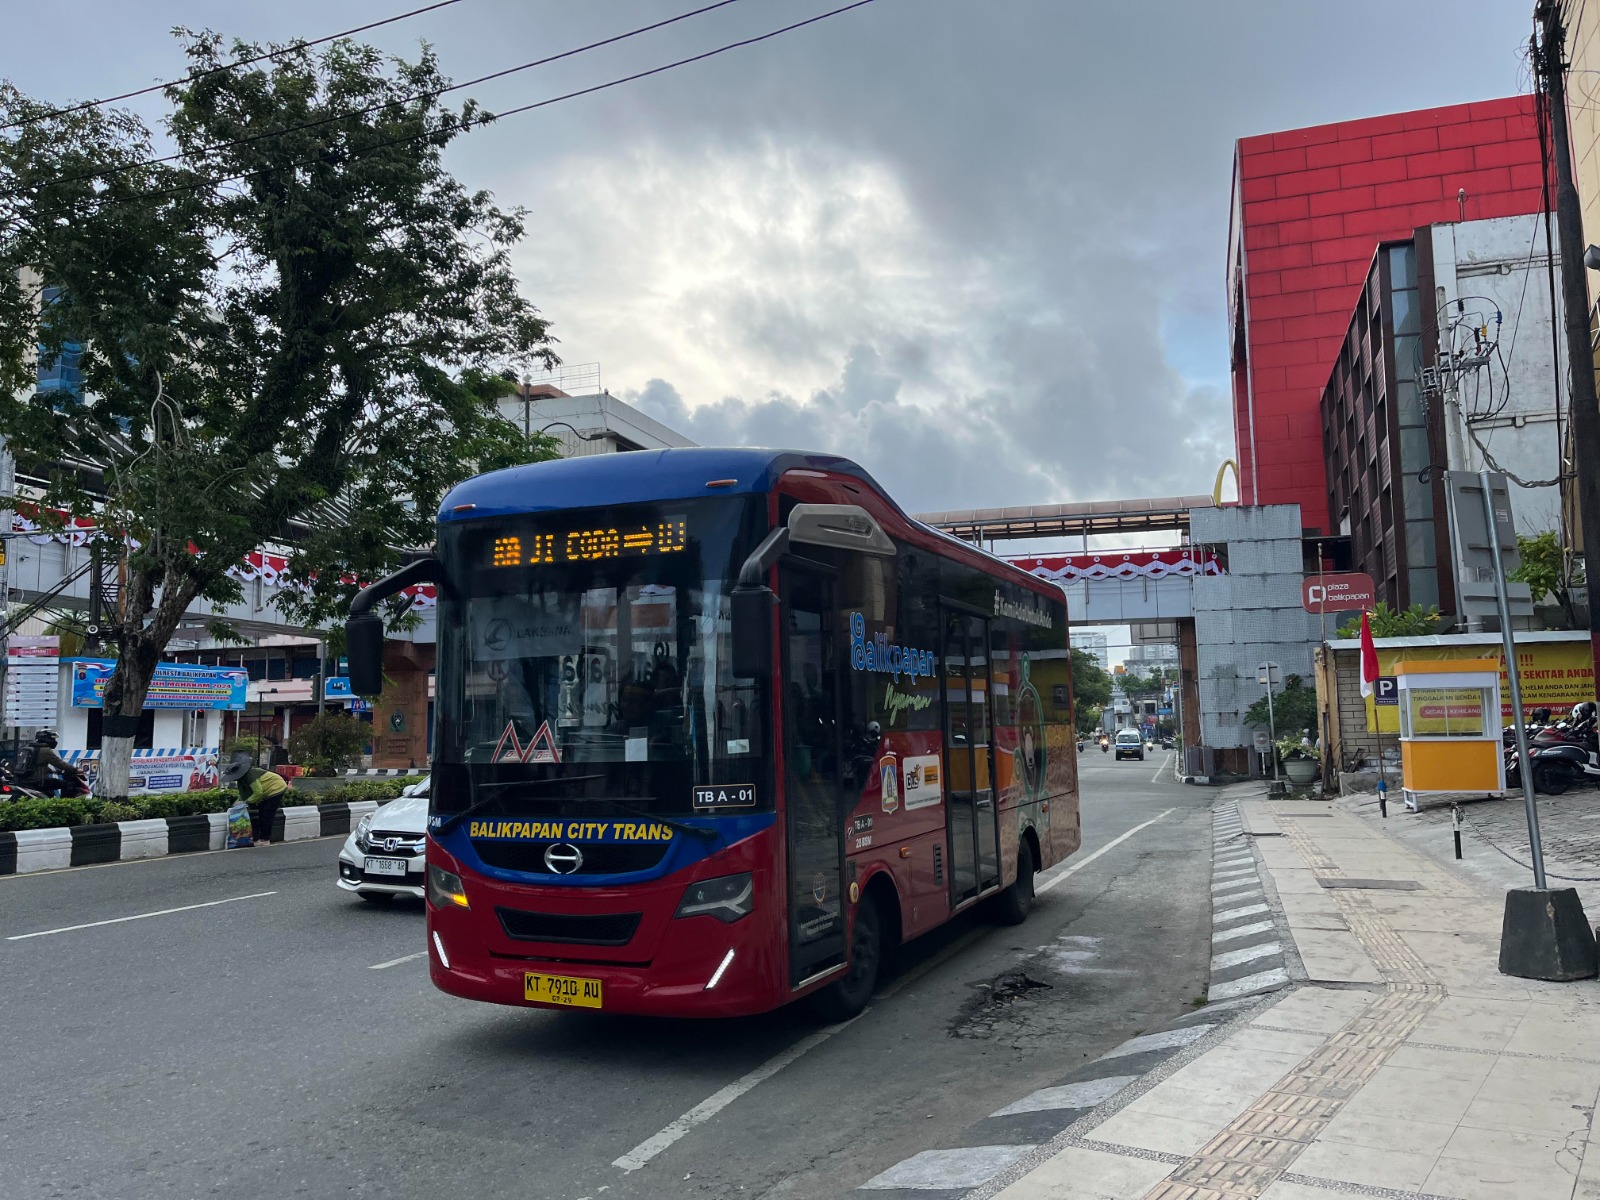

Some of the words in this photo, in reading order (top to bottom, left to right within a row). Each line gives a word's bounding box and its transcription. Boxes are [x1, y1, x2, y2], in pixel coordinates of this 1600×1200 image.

[1327, 583, 1350, 592] plaza
[1328, 593, 1370, 602] balikpapan
[850, 611, 937, 686] Balikpapan
[1523, 669, 1565, 680] SEKITAR
[1566, 668, 1595, 678] ANDA
[1379, 680, 1393, 696] P
[1521, 691, 1538, 699] ALAM
[1538, 690, 1575, 698] KENDARAAN
[1449, 707, 1482, 715] KEHILANG
[696, 791, 714, 803] TB
[717, 790, 728, 802] A
[738, 789, 753, 801] 01
[469, 821, 563, 839] BALIKPAPAN
[567, 822, 609, 839] CITY
[613, 823, 674, 841] TRANS
[366, 860, 374, 869] KT
[526, 975, 541, 992] KT
[547, 978, 577, 996] 7910
[583, 981, 599, 998] AU
